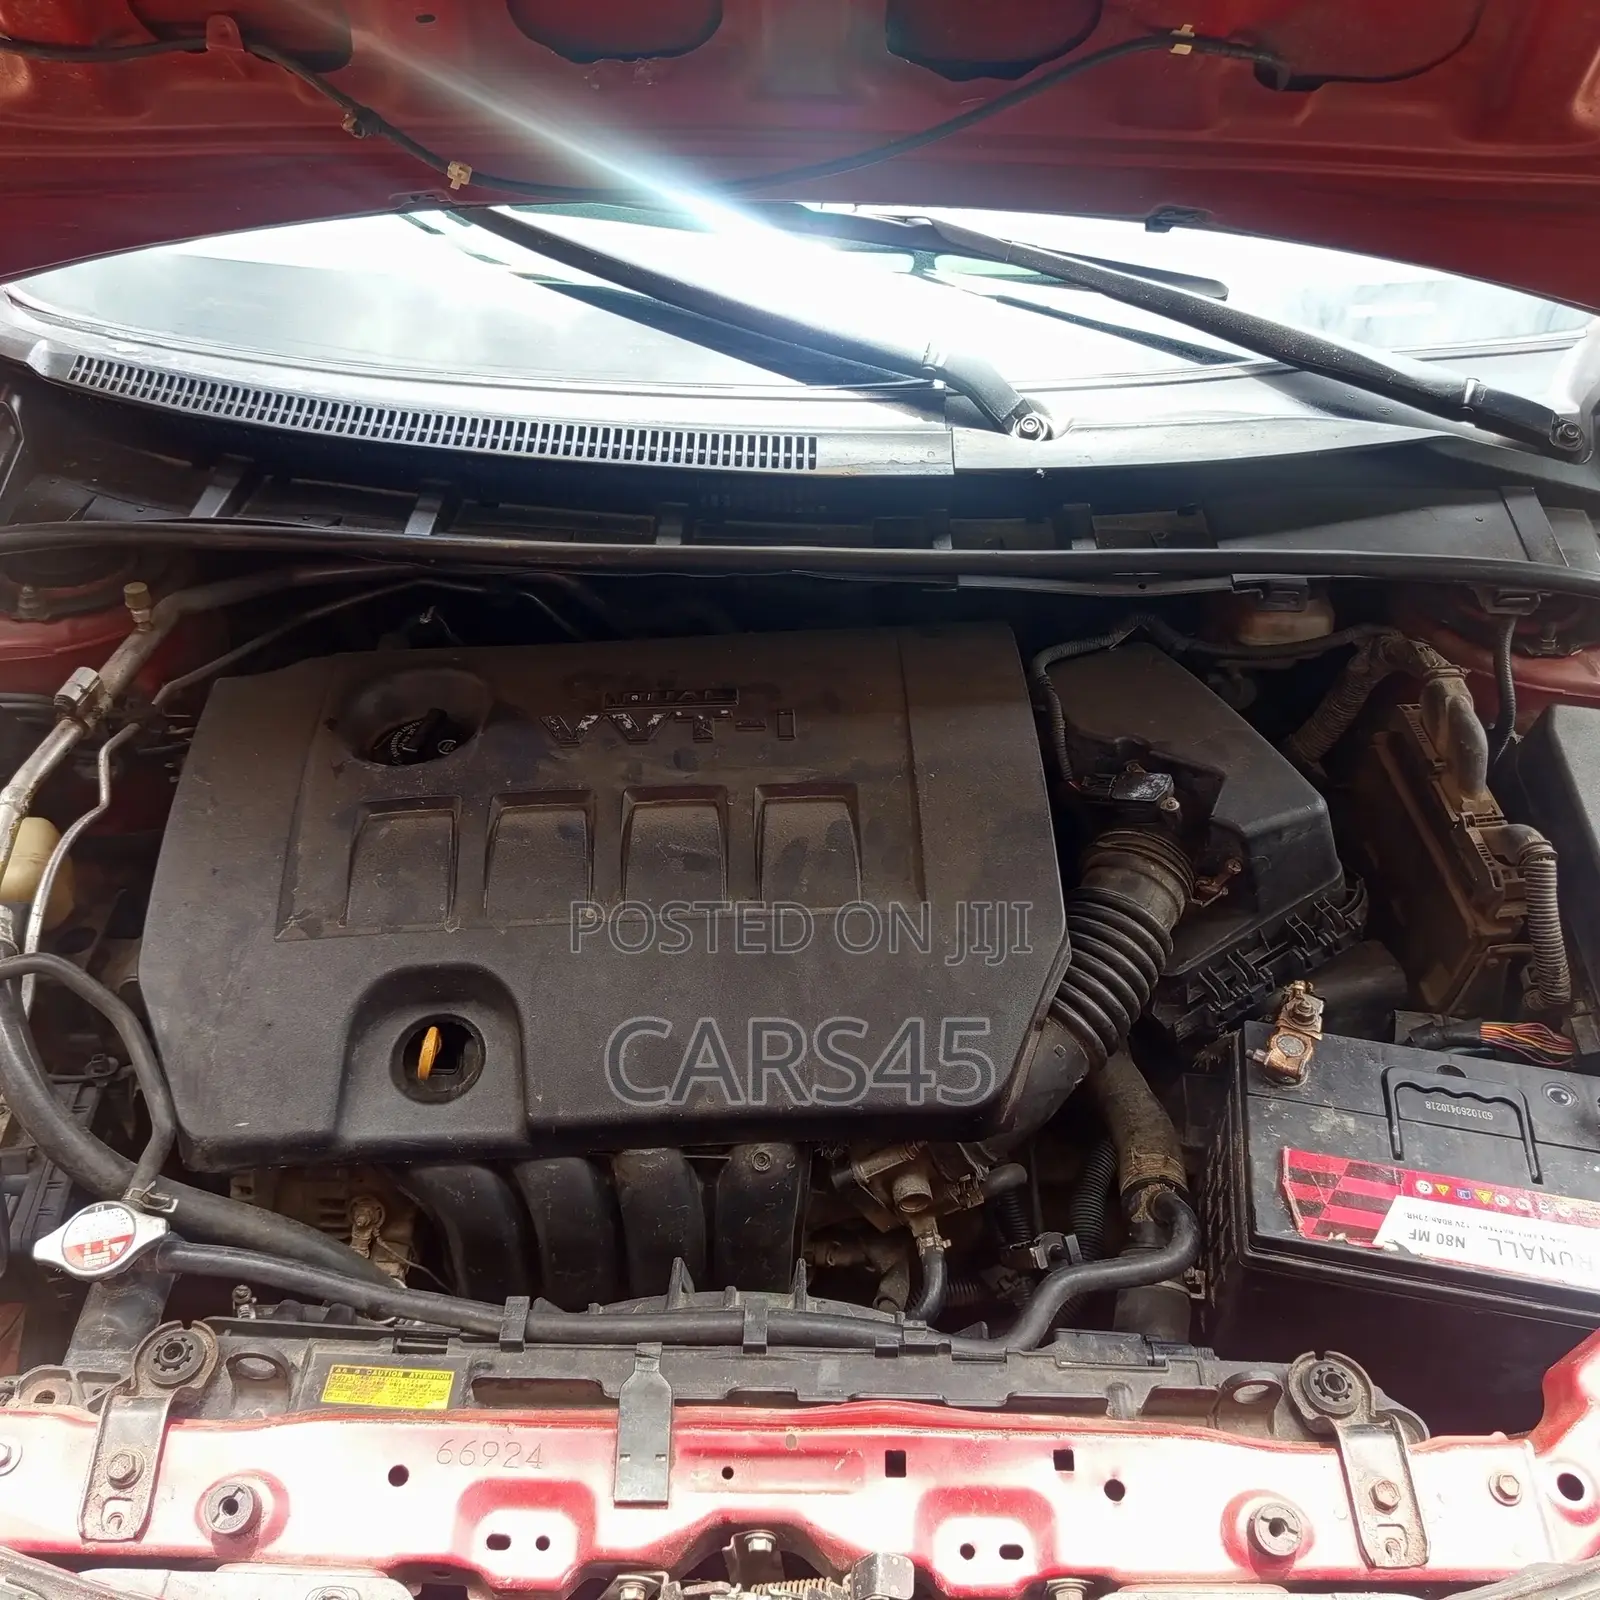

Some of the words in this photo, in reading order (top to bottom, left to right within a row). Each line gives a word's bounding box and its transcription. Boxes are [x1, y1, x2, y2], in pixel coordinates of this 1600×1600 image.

[1408, 1228, 1430, 1243] MF
[1436, 1232, 1466, 1249] N80
[366, 1369, 404, 1378] CAUTION
[408, 1371, 450, 1380] ATTENTION
[436, 1438, 543, 1470] 66924
